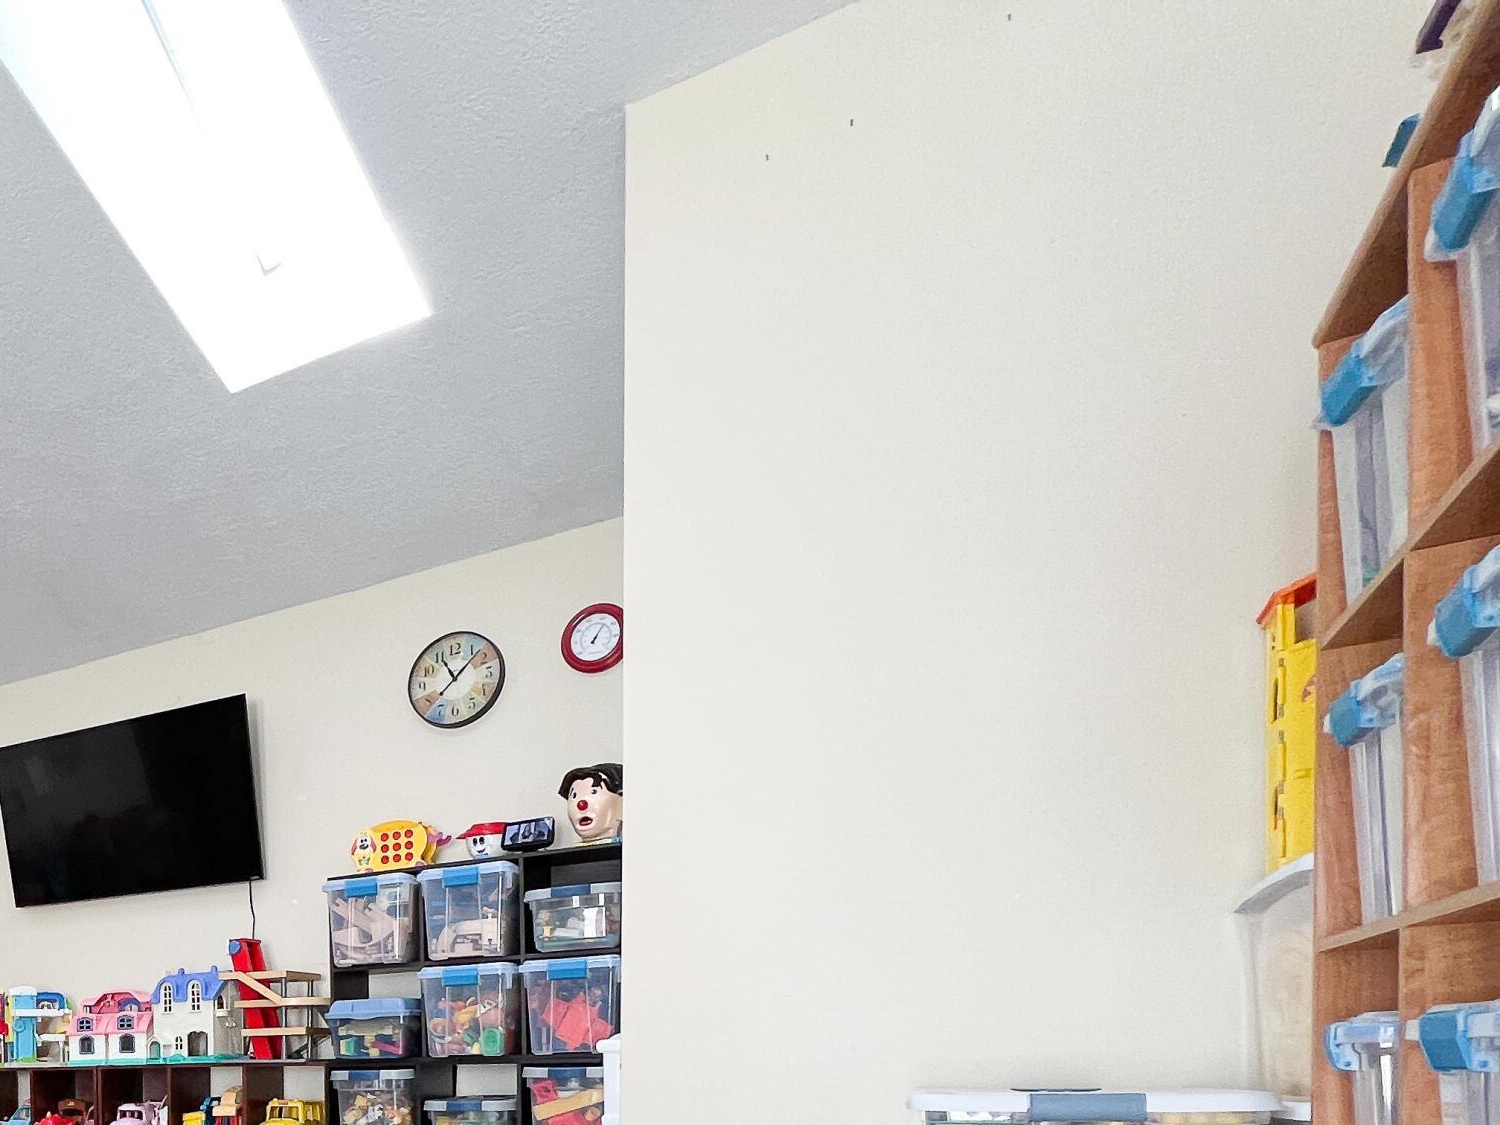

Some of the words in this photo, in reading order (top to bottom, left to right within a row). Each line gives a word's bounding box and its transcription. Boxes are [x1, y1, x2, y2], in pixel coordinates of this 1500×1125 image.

[449, 643, 461, 656] 12
[470, 644, 473, 655] 1
[435, 652, 444, 663] 11
[481, 652, 488, 664] 2
[424, 665, 434, 677] 10
[419, 682, 426, 691] 9
[468, 697, 476, 709] 5
[437, 704, 444, 716] 7
[452, 705, 459, 716] 6
